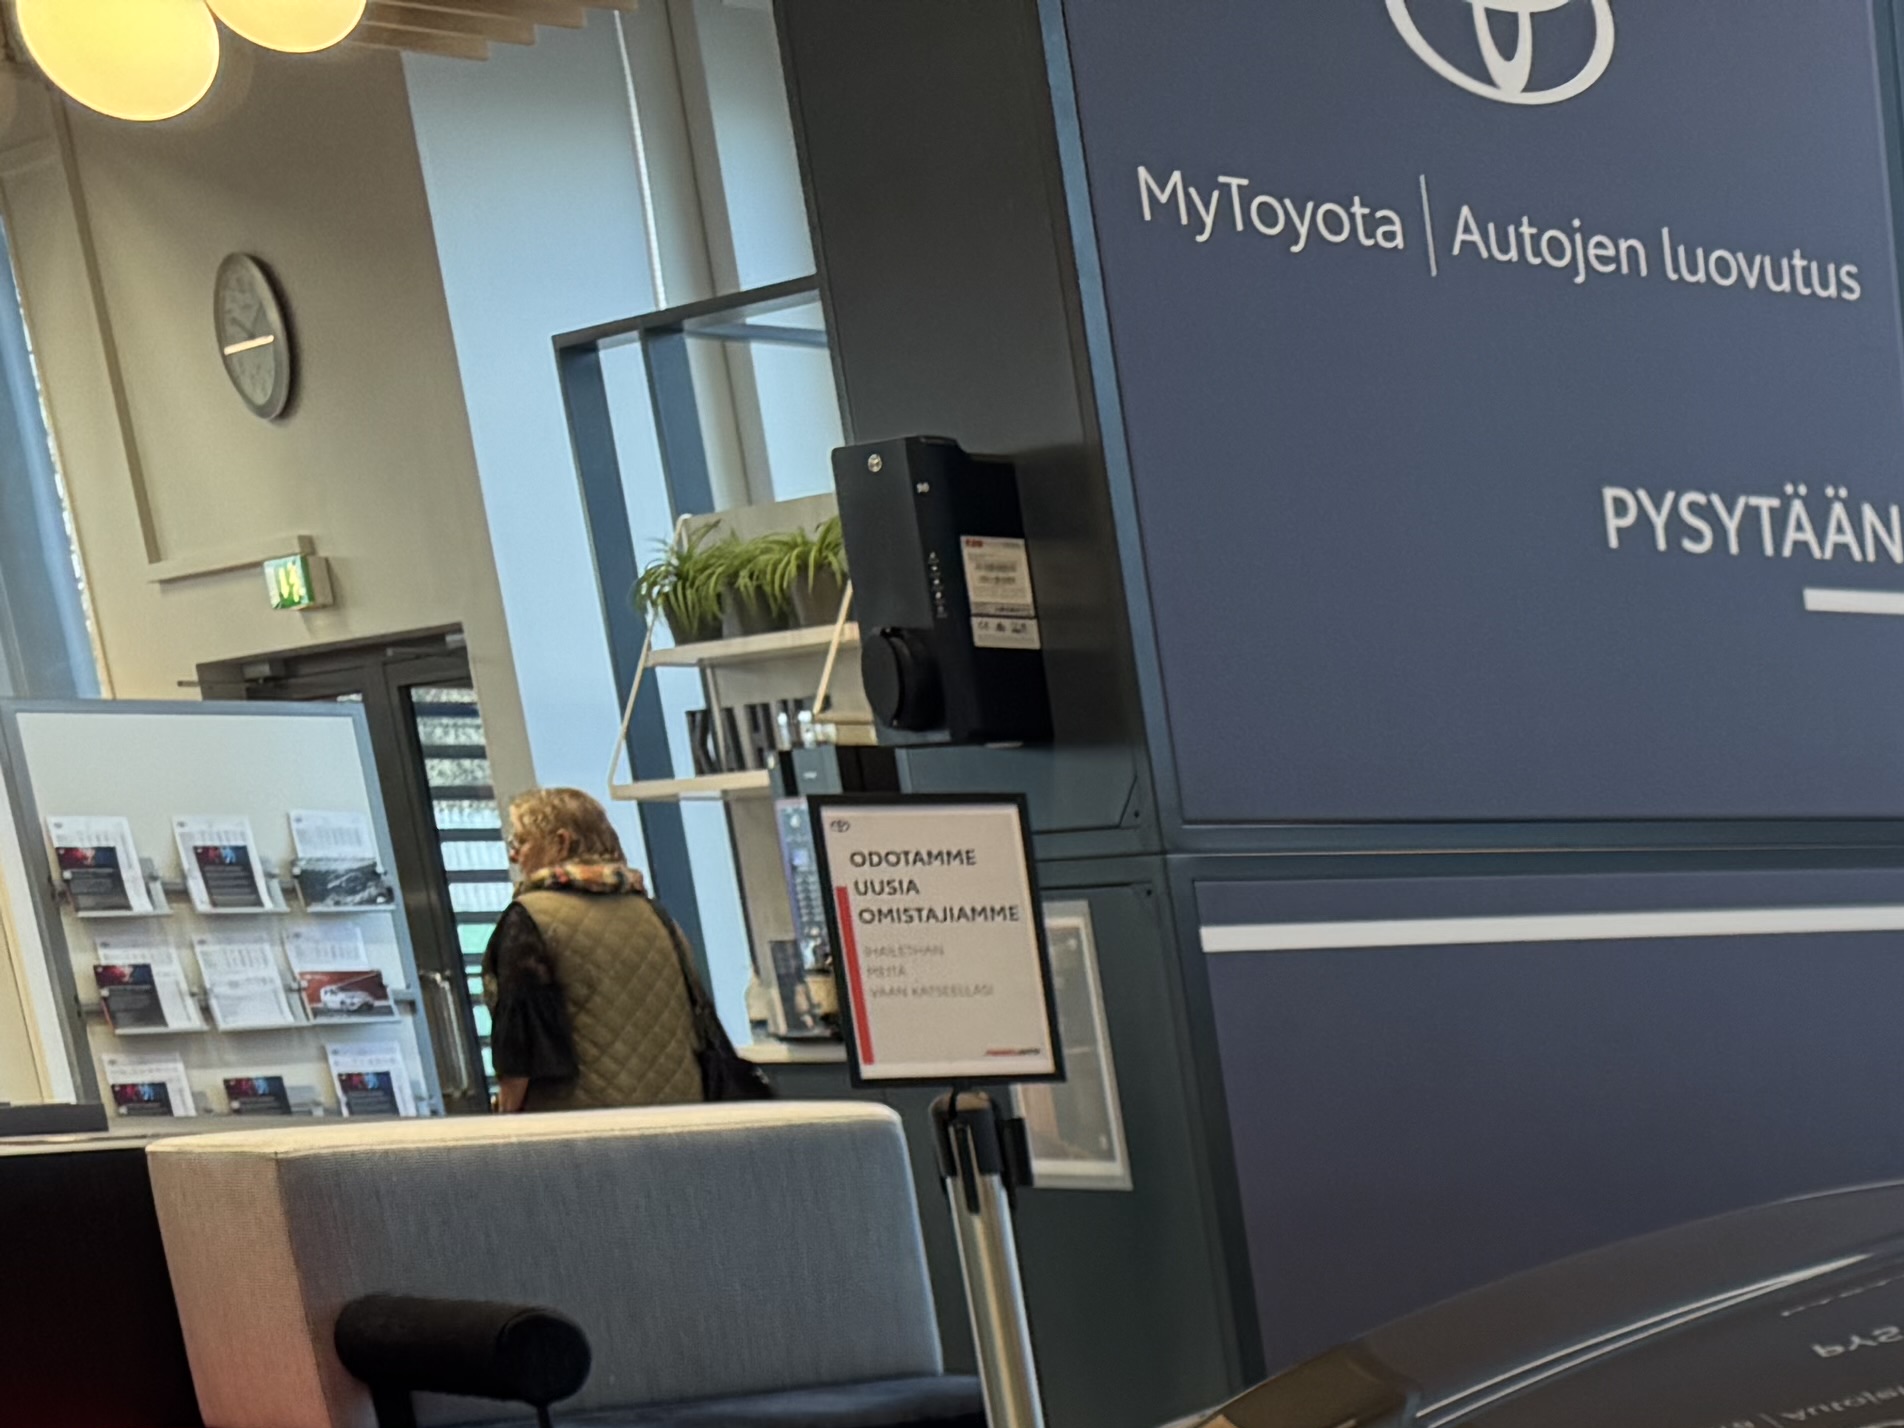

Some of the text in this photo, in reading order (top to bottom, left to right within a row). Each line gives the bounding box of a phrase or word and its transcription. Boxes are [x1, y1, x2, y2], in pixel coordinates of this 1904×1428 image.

[1136, 165, 1862, 302] MyToyota Autojen luovutus
[1601, 482, 1904, 565] PYSYTÄÄN
[850, 848, 977, 868] ODOTAMME
[853, 879, 920, 896] UUSIA
[858, 904, 1020, 925] OMISTAJIAMME
